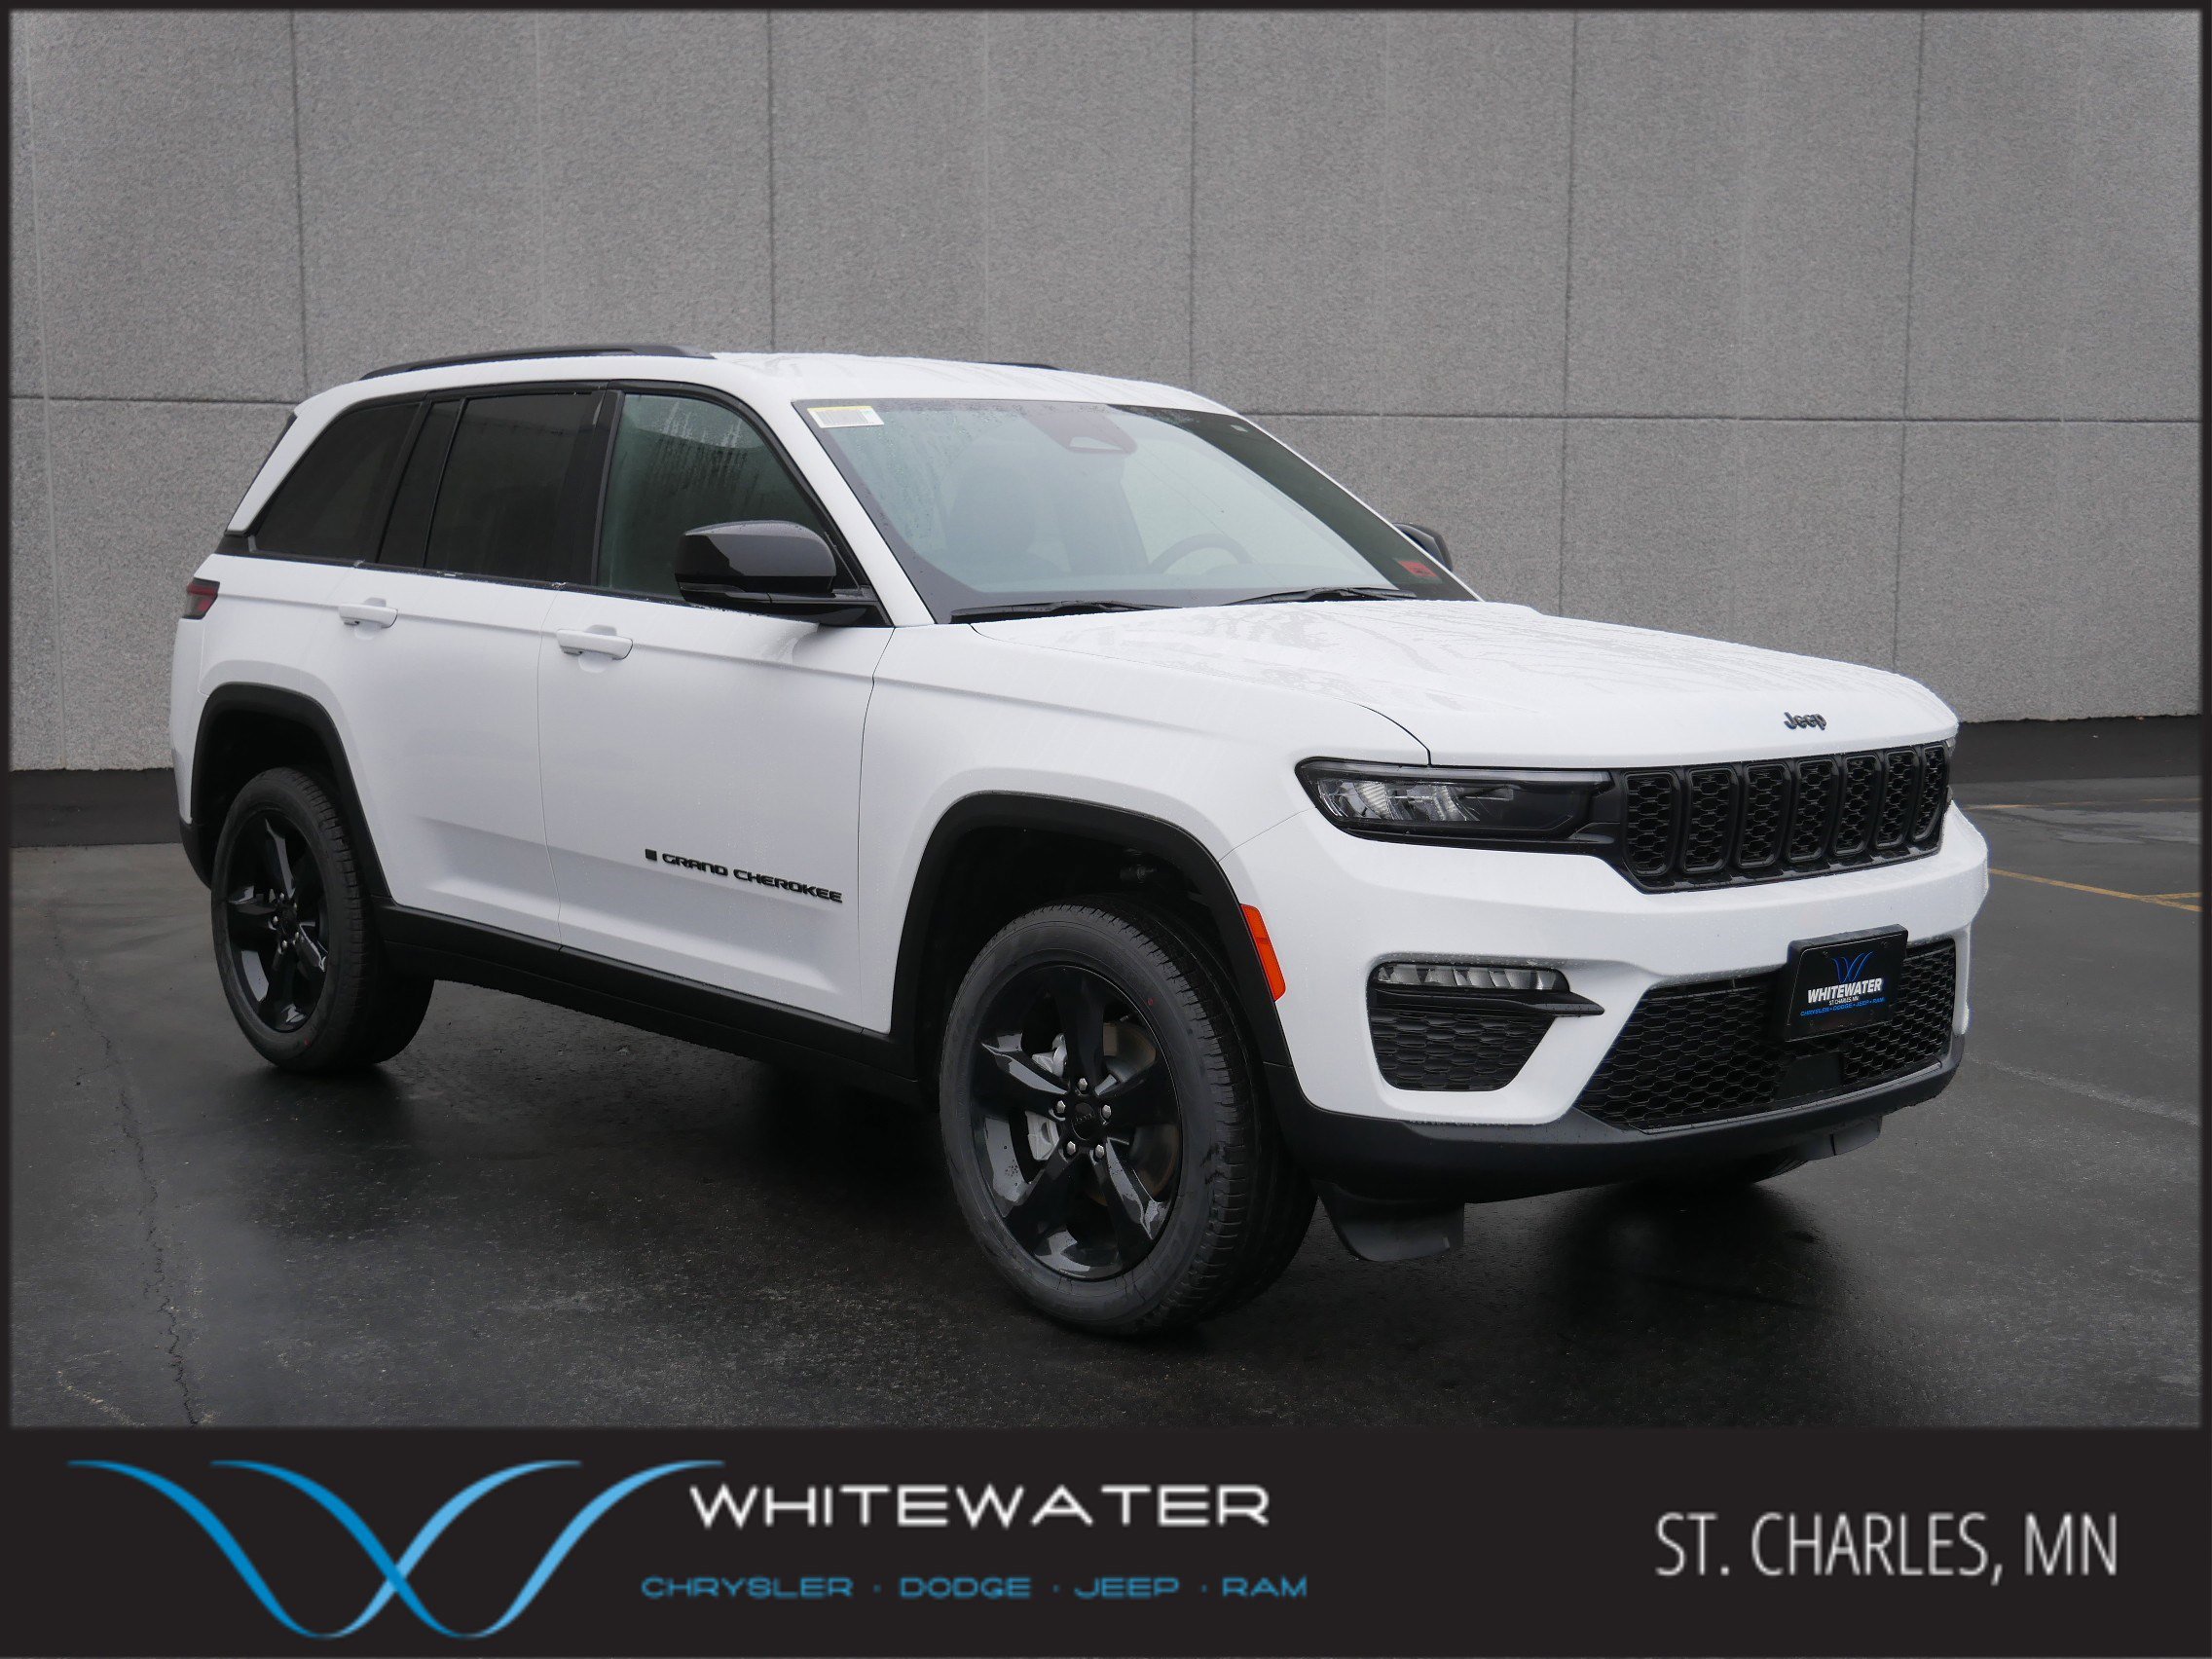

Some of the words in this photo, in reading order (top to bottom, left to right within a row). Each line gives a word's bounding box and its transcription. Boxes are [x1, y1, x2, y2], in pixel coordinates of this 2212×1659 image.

[1784, 711, 1827, 731] Jeep
[661, 852, 728, 877] GRAND
[733, 868, 843, 903] CHEROKEE
[1808, 977, 1883, 1003] WHITEWATER
[1832, 1003, 1853, 1012] DODGE
